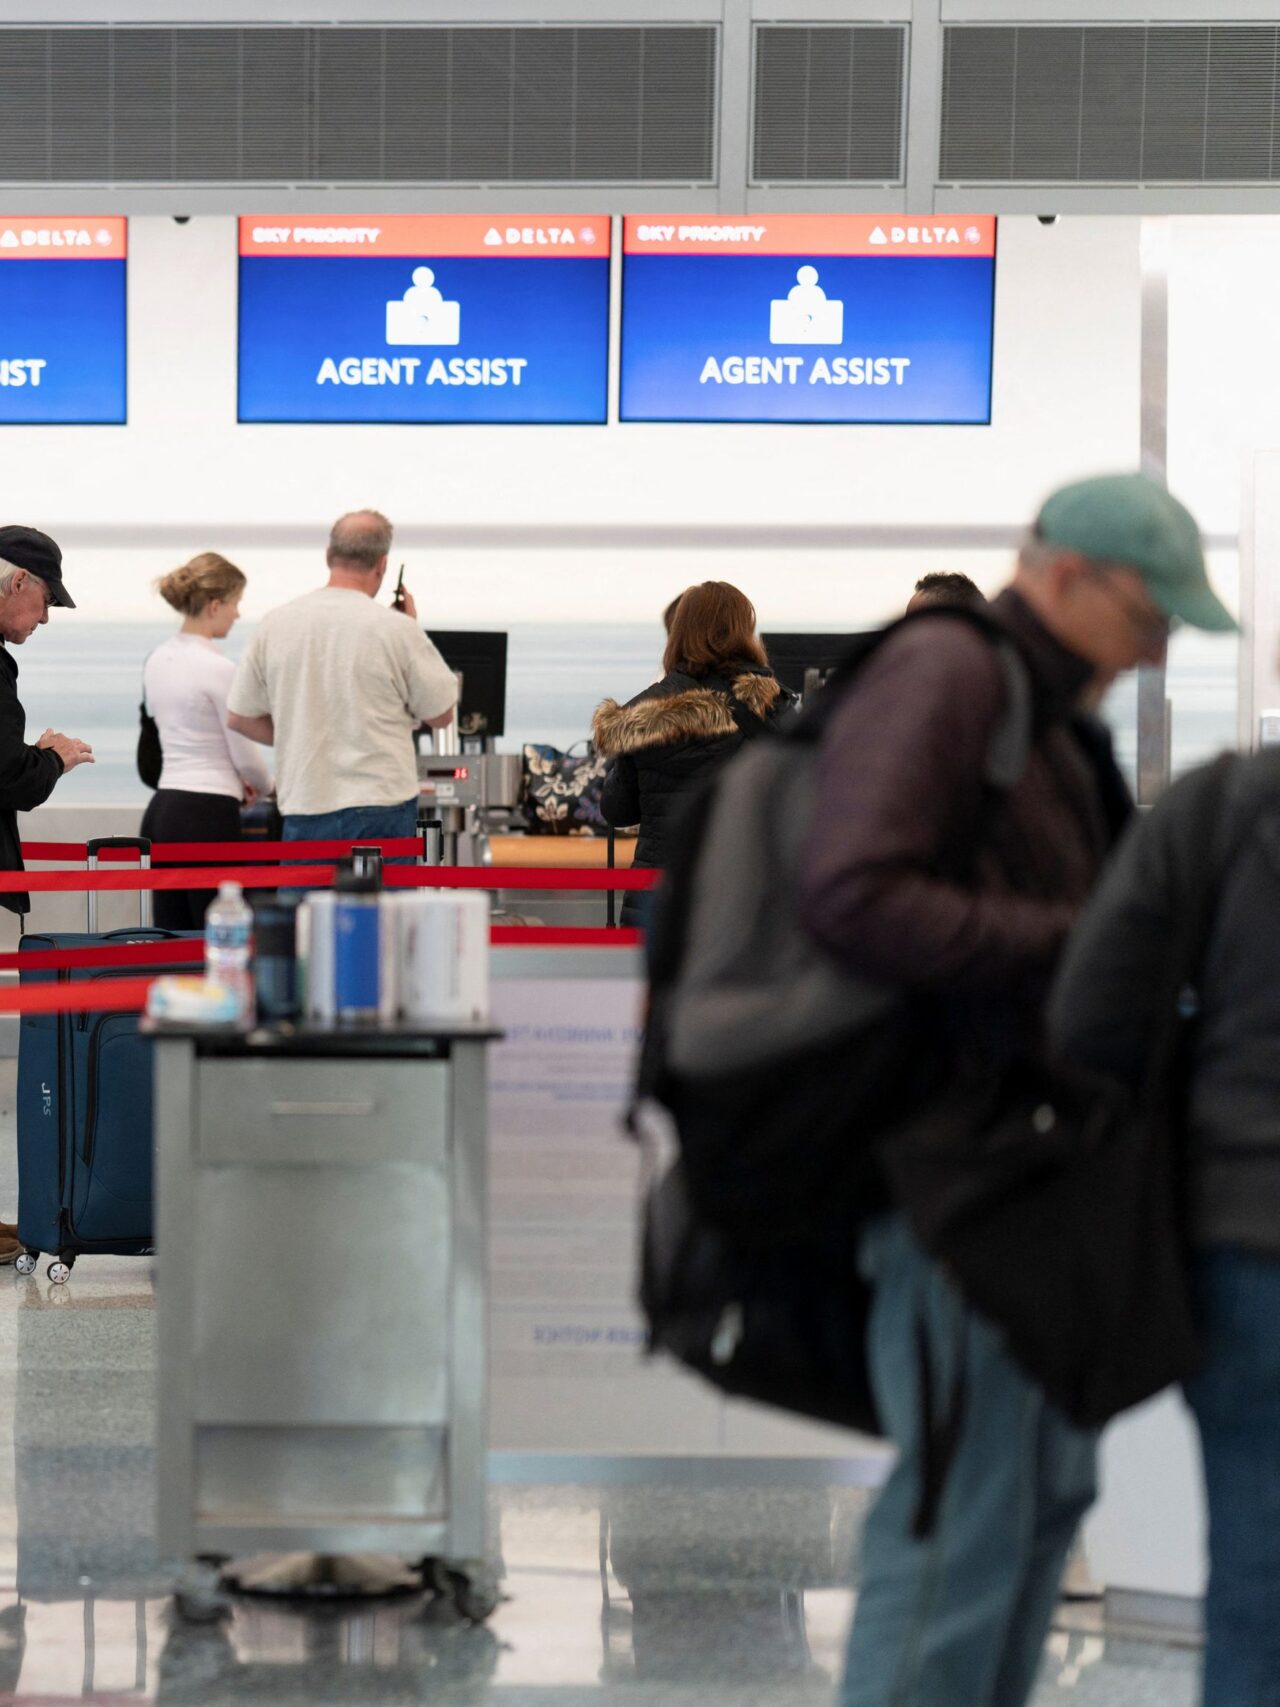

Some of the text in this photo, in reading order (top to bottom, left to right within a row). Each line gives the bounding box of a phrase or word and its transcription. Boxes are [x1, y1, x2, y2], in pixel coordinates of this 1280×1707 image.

[20, 230, 92, 247] DELTA
[293, 227, 381, 243] PRIORITY
[505, 227, 575, 244] DELTA
[678, 225, 766, 242] PRIORITY
[891, 227, 960, 244] DELTA
[316, 357, 528, 386] AGENT ASSIST
[699, 356, 911, 385] AGENT ASSIST
[41, 1082, 52, 1117] JPS
